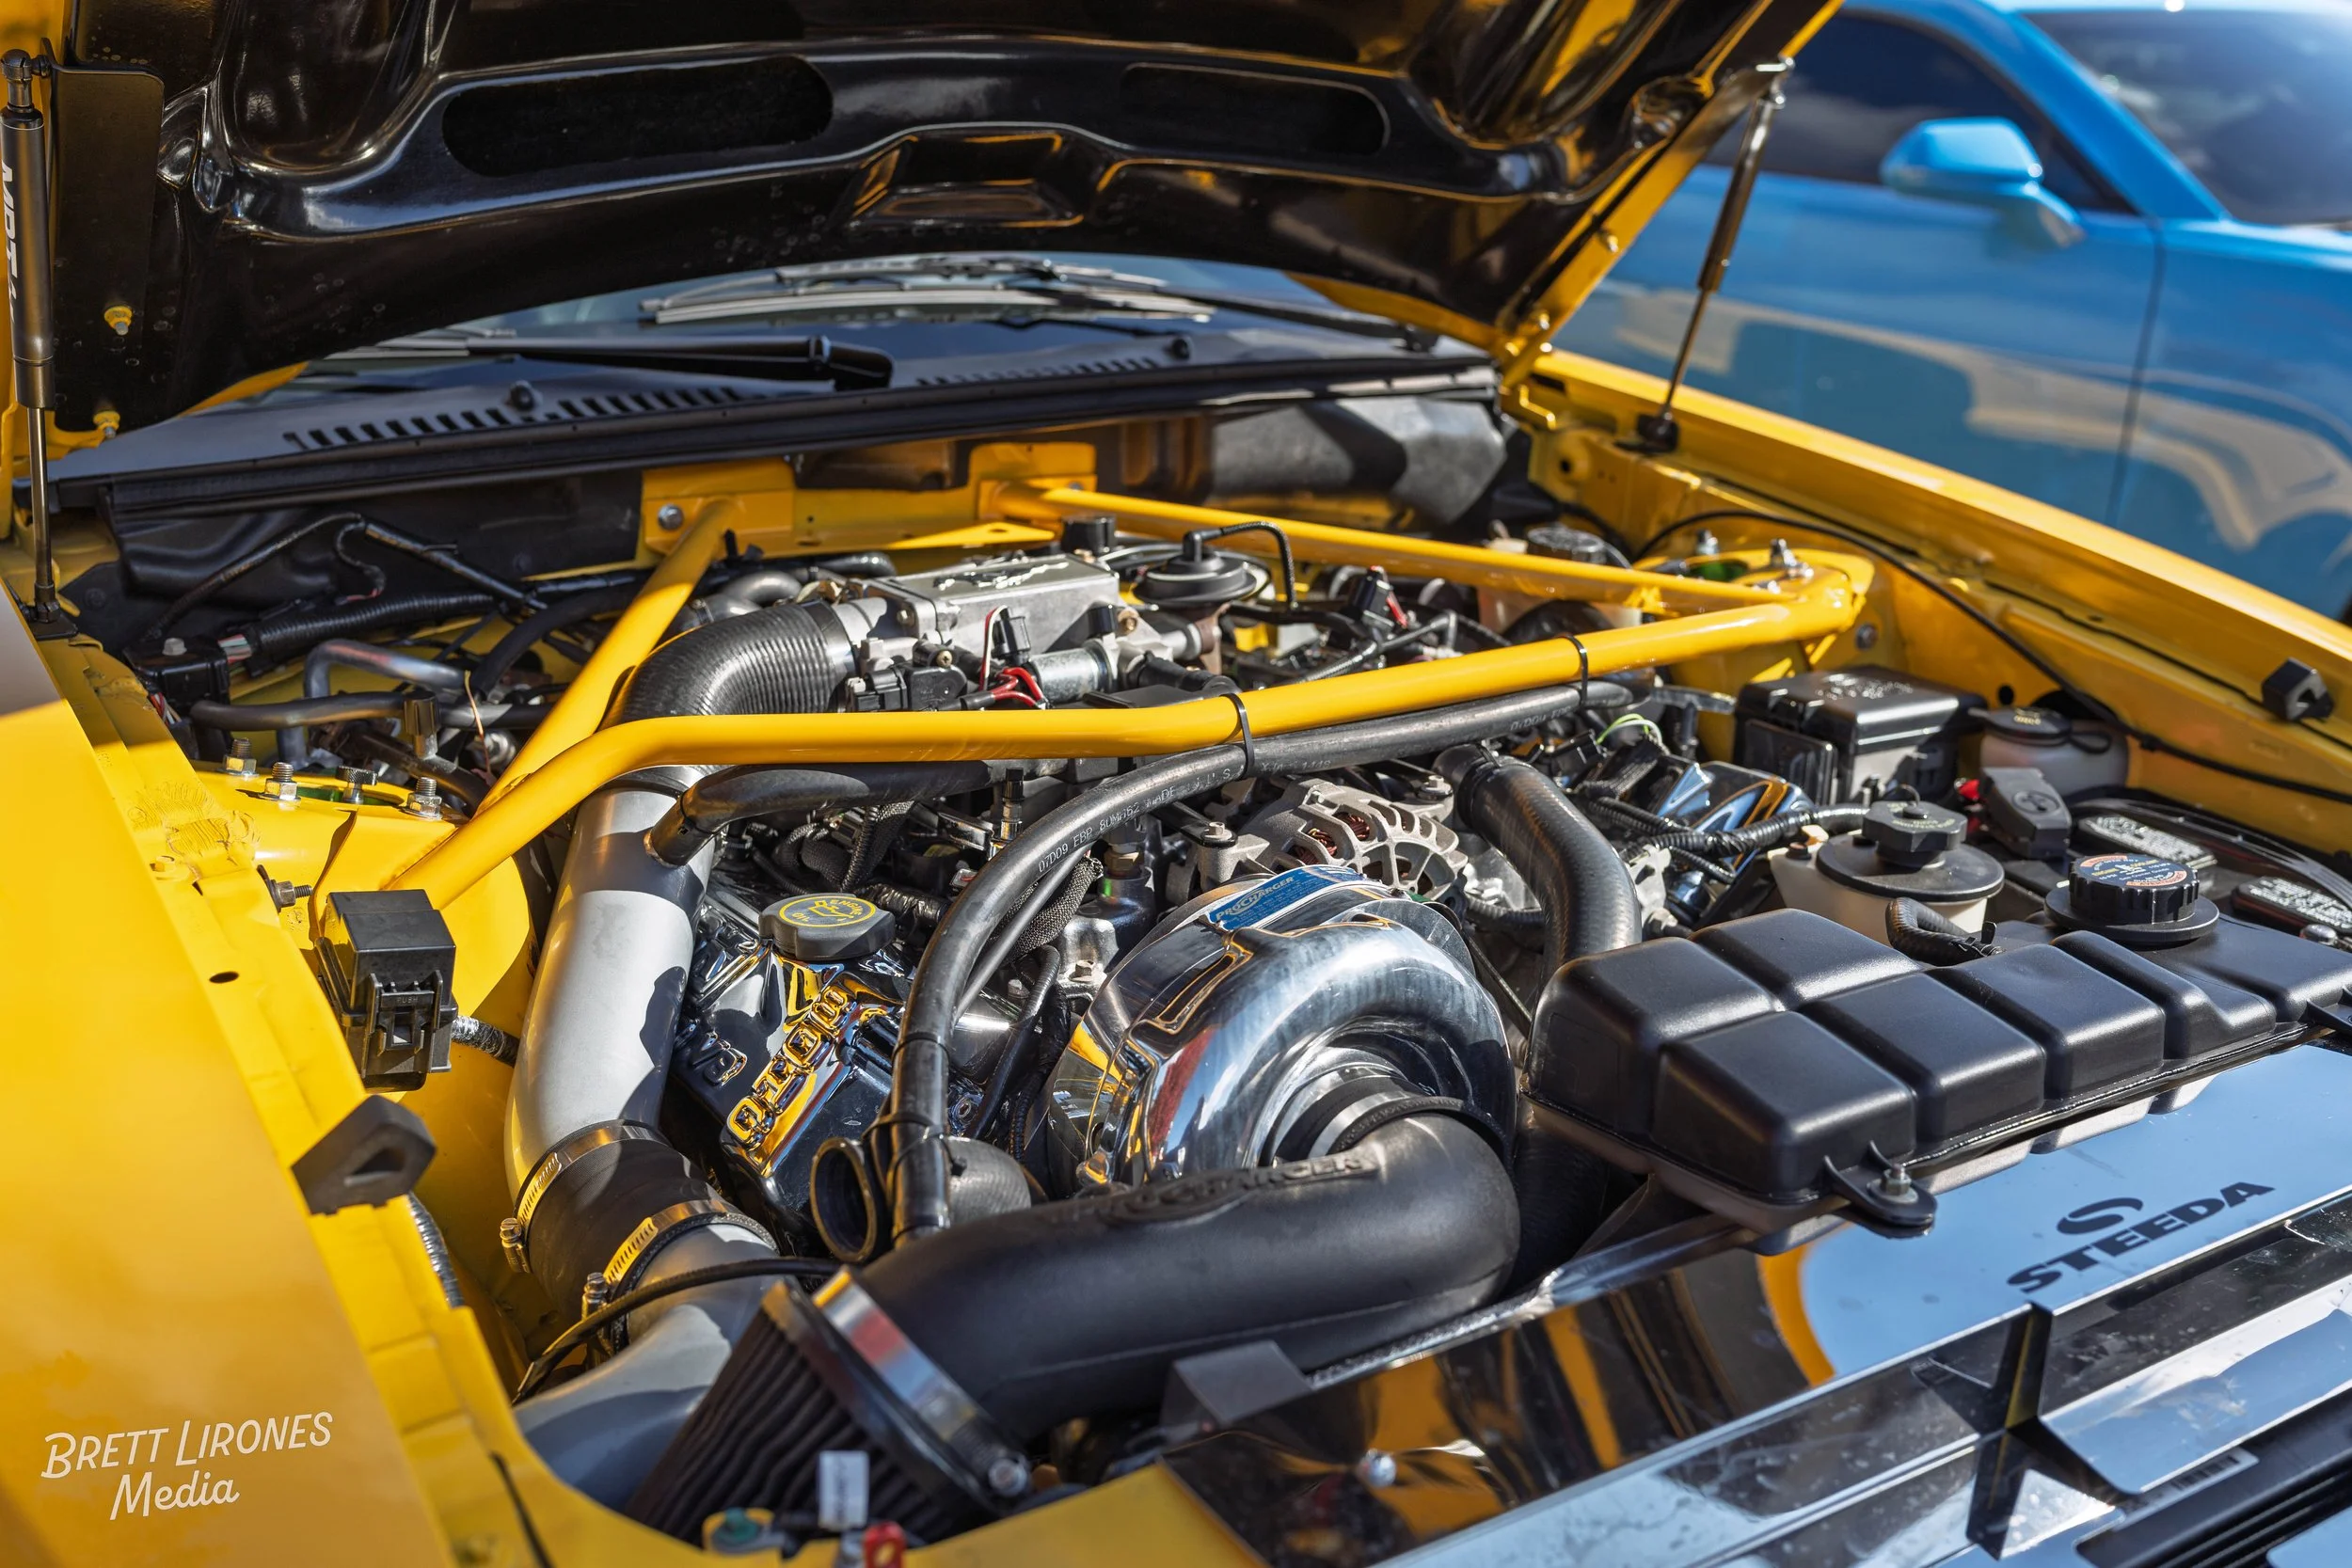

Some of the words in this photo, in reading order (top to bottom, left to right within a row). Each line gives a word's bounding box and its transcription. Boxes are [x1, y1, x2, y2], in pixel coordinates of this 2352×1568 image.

[1073, 826, 1093, 849] EBP
[830, 899, 864, 915] ENGINE
[1216, 876, 1295, 920] PROCHARGER
[791, 911, 810, 922] OIL
[396, 996, 419, 1005] PUSH
[2007, 1181, 2276, 1294] STEEDA
